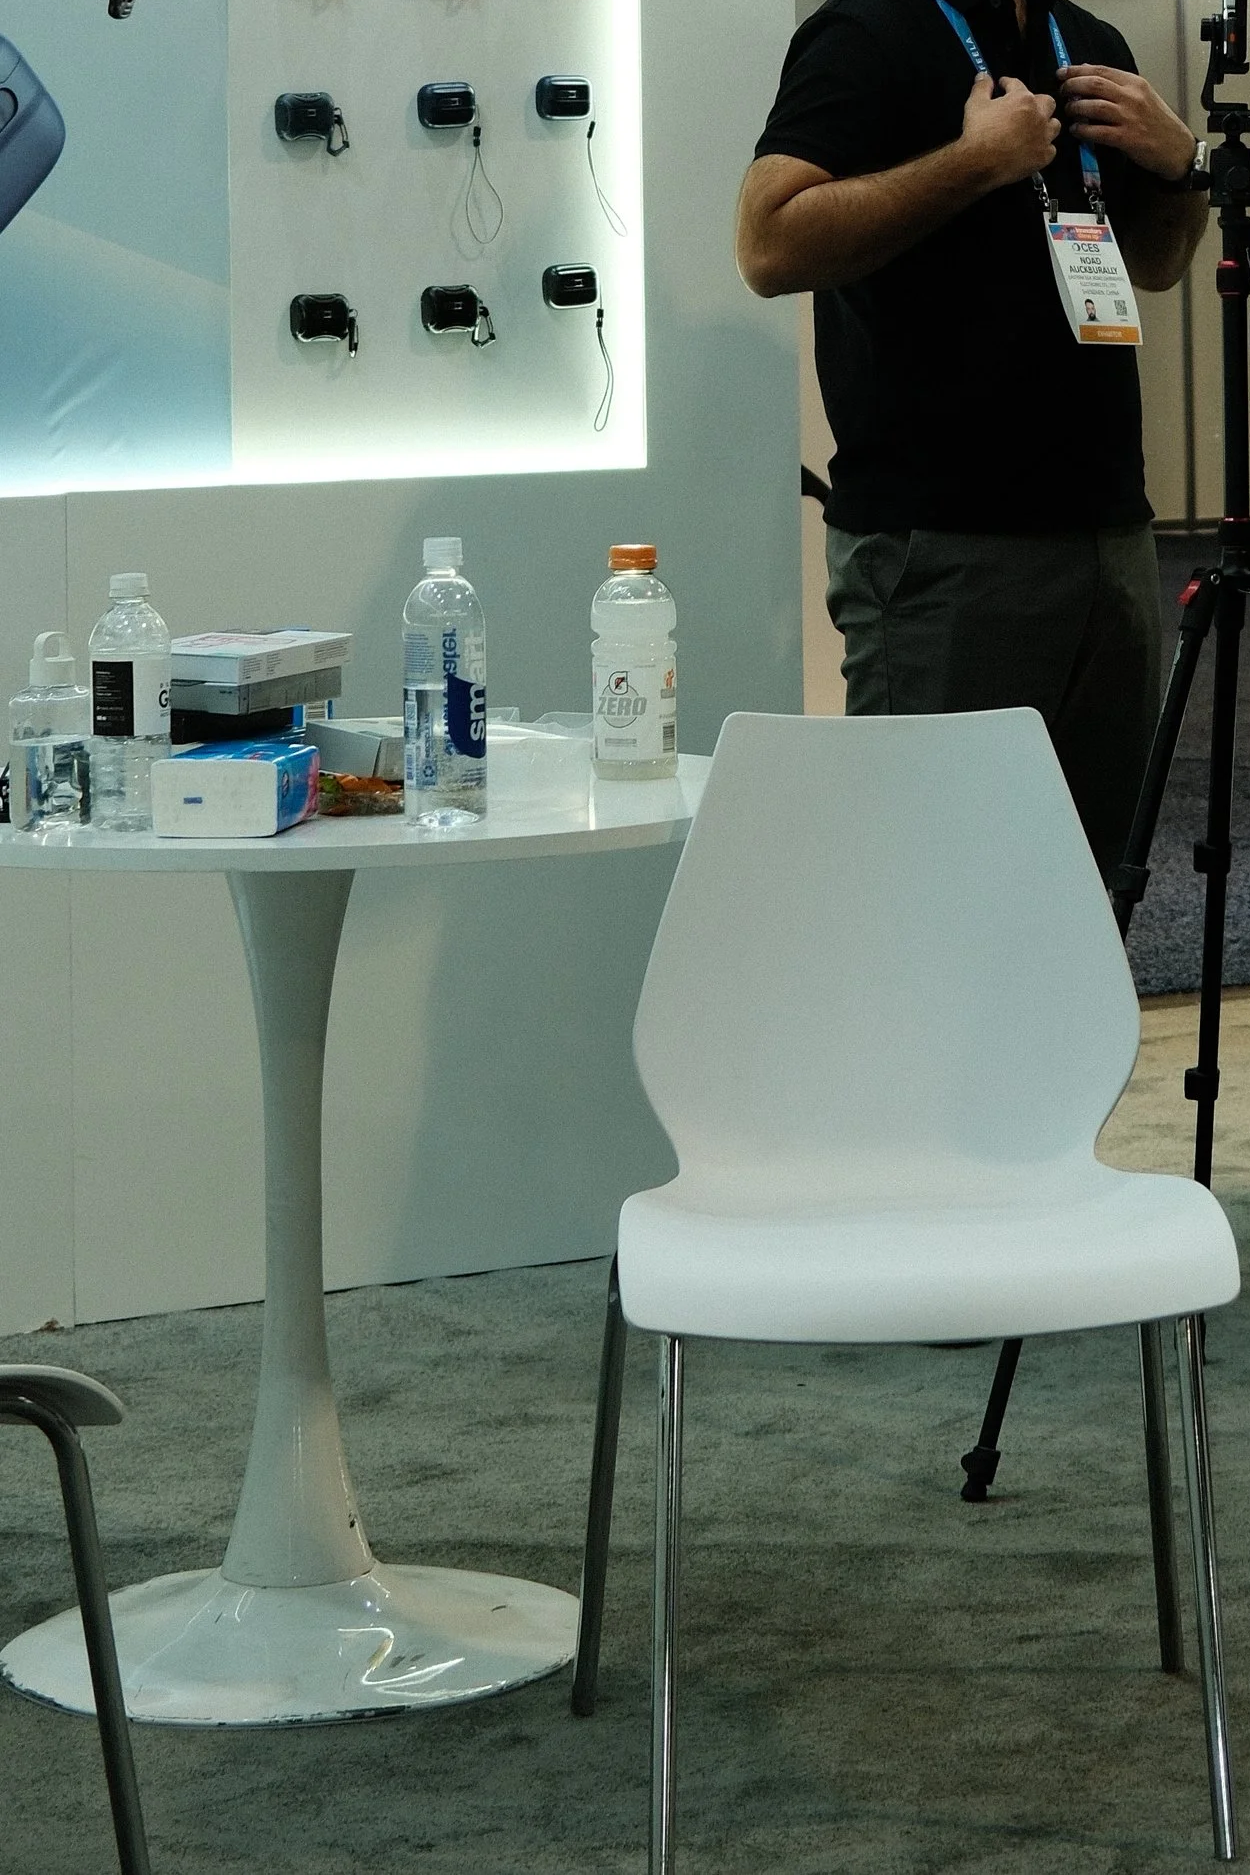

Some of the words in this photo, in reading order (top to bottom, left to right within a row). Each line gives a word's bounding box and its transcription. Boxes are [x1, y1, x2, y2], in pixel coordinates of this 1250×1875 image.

[965, 36, 988, 74] FEELA
[1081, 243, 1099, 253] CES
[597, 696, 648, 717] ZERO
